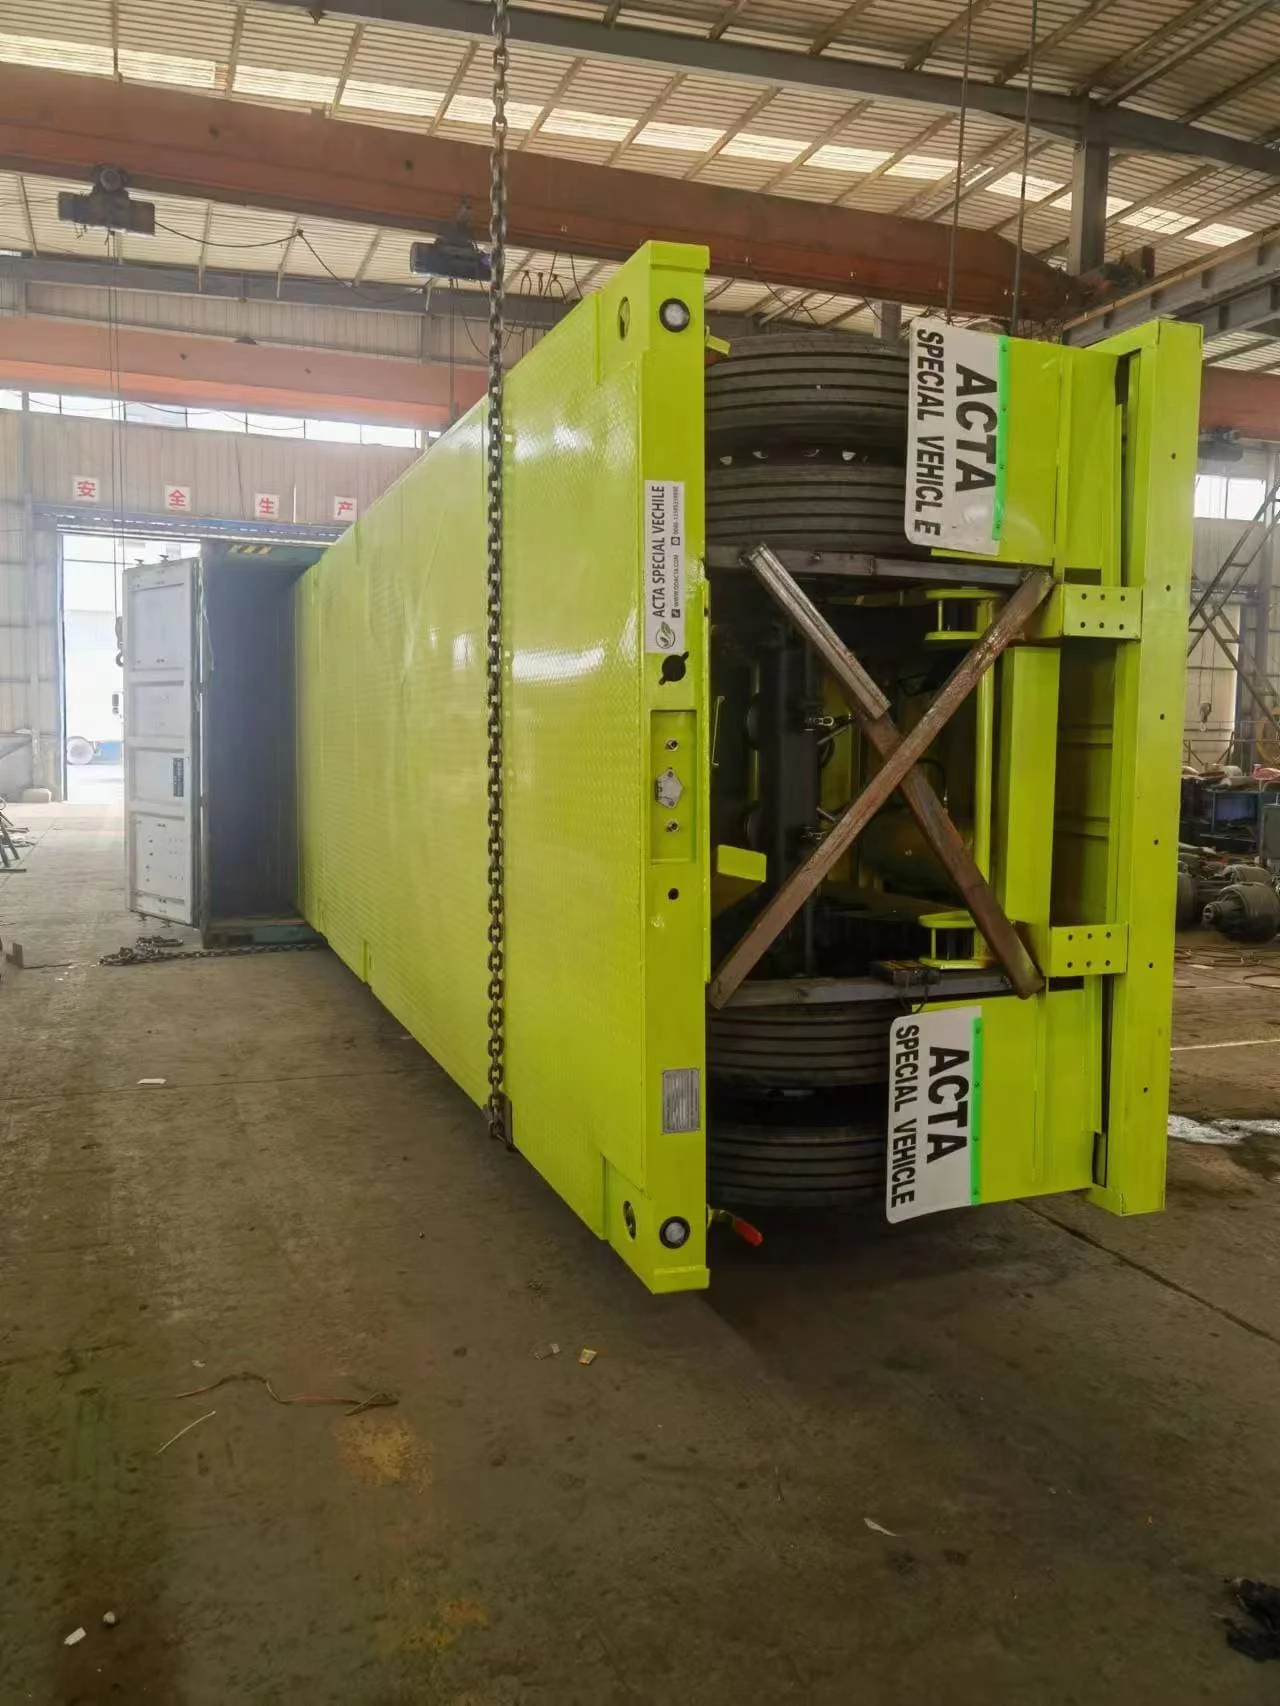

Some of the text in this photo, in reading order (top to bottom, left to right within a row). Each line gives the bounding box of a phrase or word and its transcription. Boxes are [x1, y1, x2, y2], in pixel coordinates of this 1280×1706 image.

[916, 328, 945, 421] SPECIAL
[954, 363, 998, 492] ACTA
[651, 485, 665, 618] ACTA SPECIAL VECHILE
[890, 1024, 919, 1208] SPECIAL VEHICLE
[927, 1046, 969, 1164] ACTA
